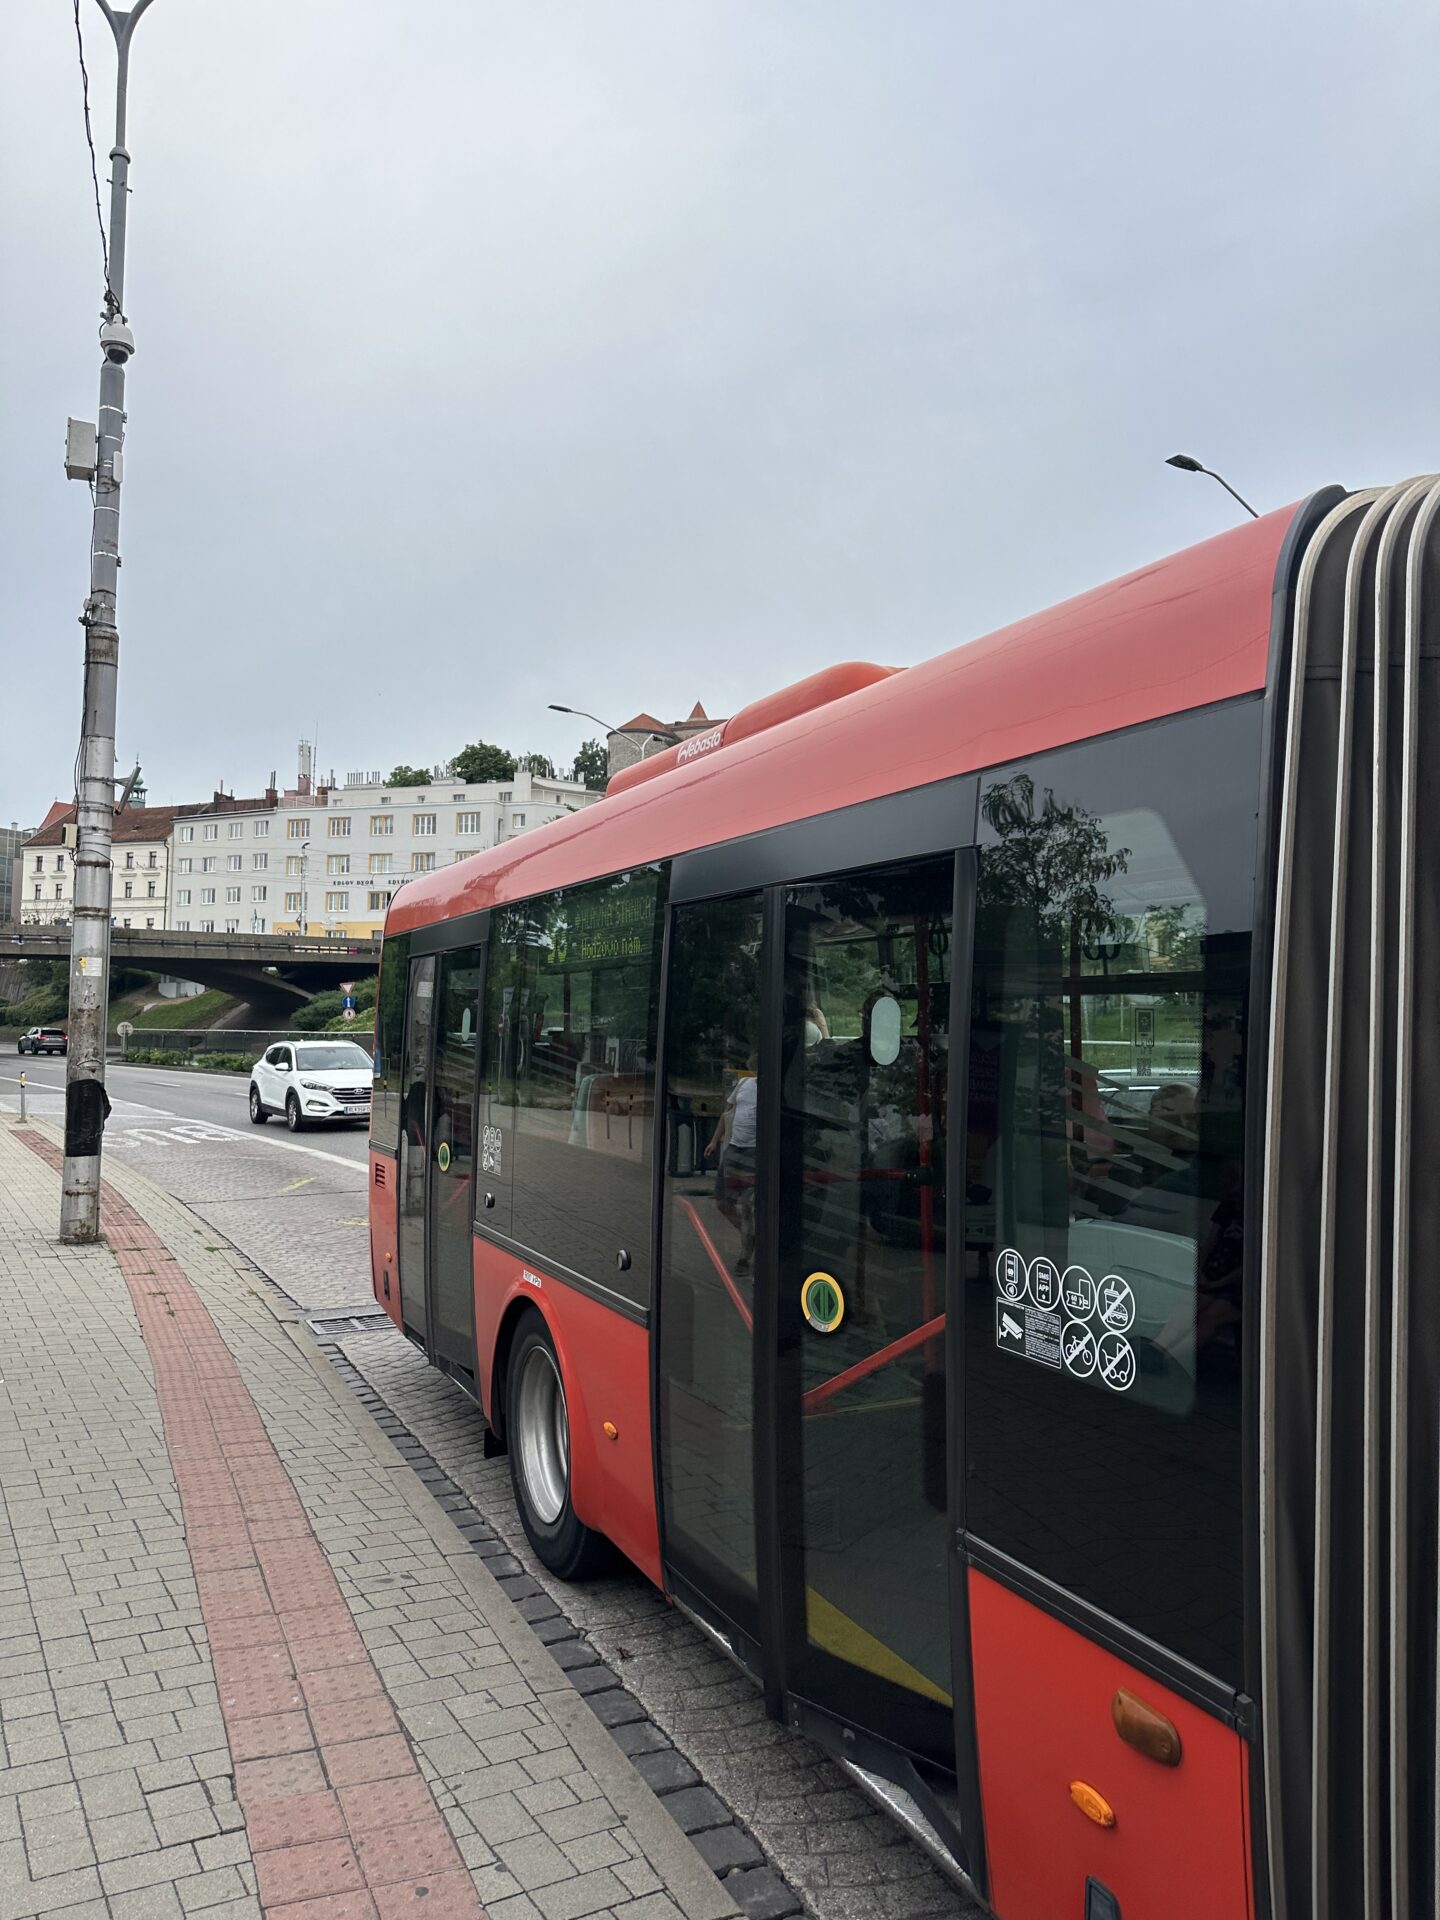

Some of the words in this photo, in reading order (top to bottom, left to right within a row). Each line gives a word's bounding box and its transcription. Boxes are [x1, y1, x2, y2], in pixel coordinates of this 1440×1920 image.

[677, 731, 721, 763] Webasto
[1038, 1271, 1050, 1280] SMS
[1038, 1283, 1050, 1292] APP
